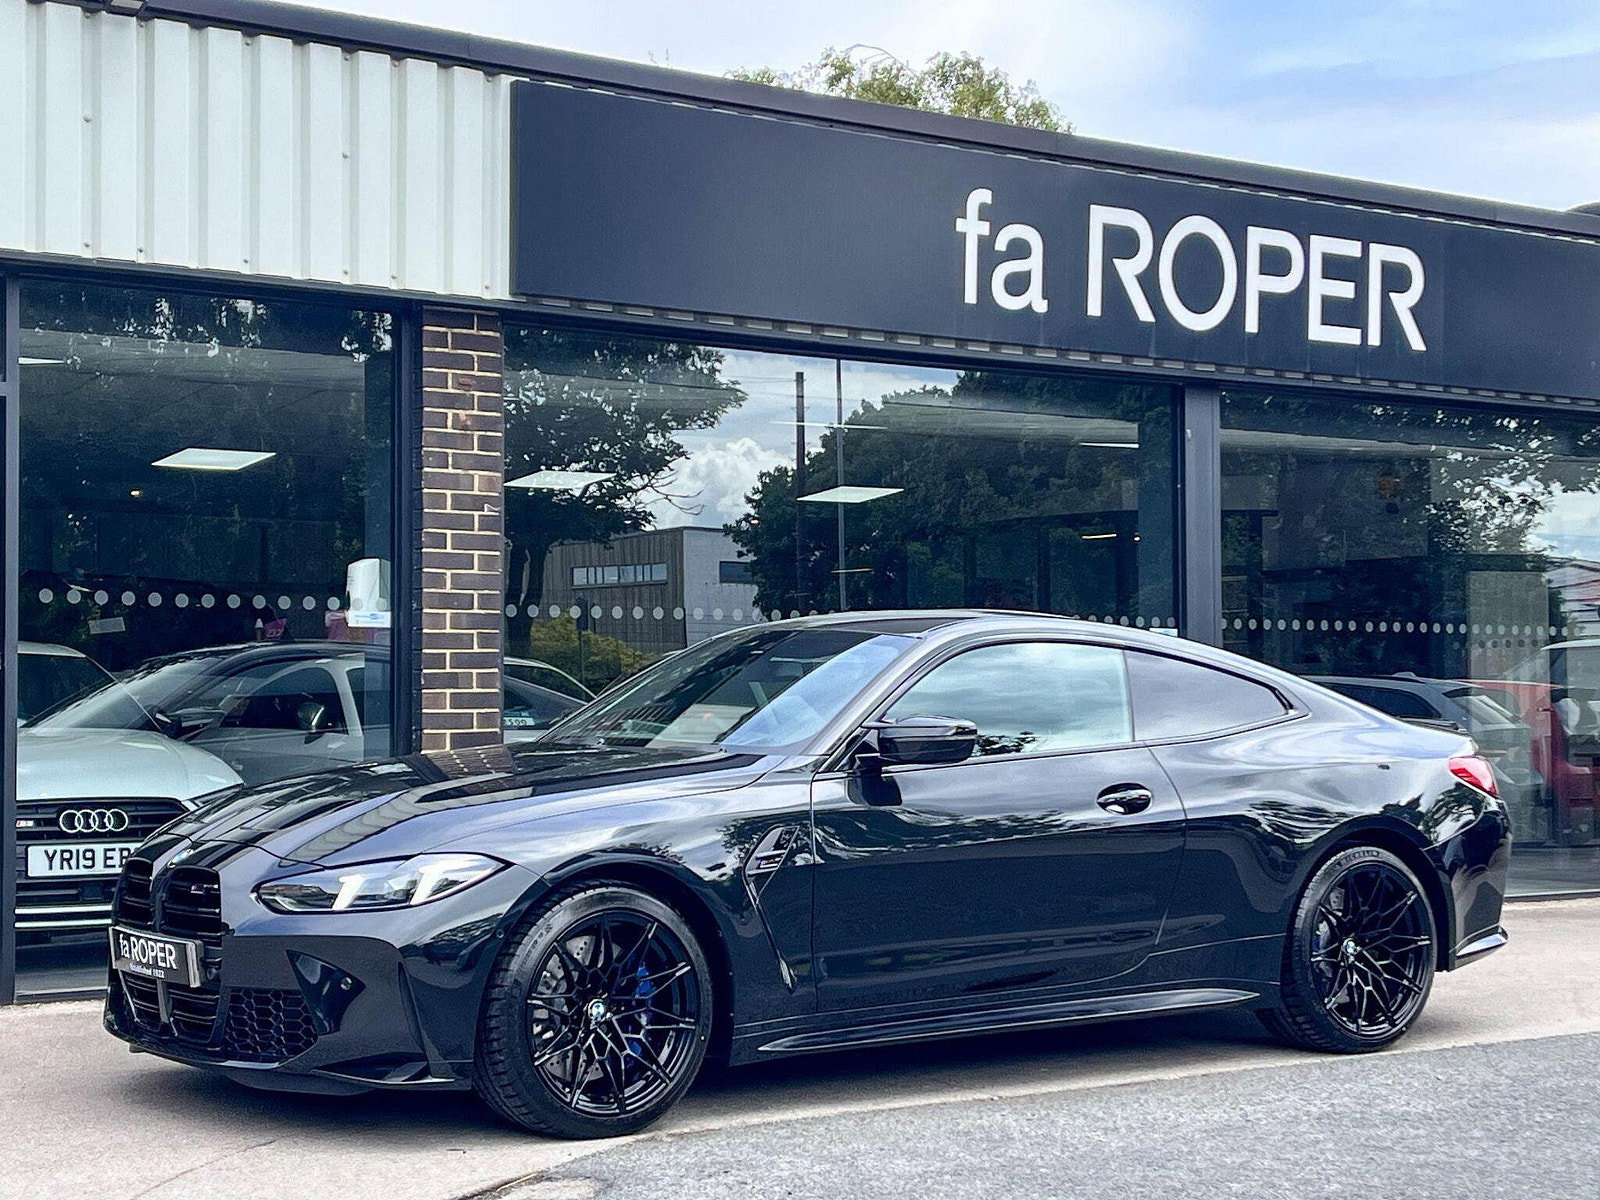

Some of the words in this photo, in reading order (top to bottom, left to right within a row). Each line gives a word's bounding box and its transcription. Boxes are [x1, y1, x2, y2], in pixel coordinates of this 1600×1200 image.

[955, 187, 1049, 314] fa
[1086, 203, 1427, 352] ROPER
[44, 848, 96, 871] YR19
[103, 847, 139, 869] EB
[119, 933, 130, 959] fa
[130, 936, 178, 970] ROPER
